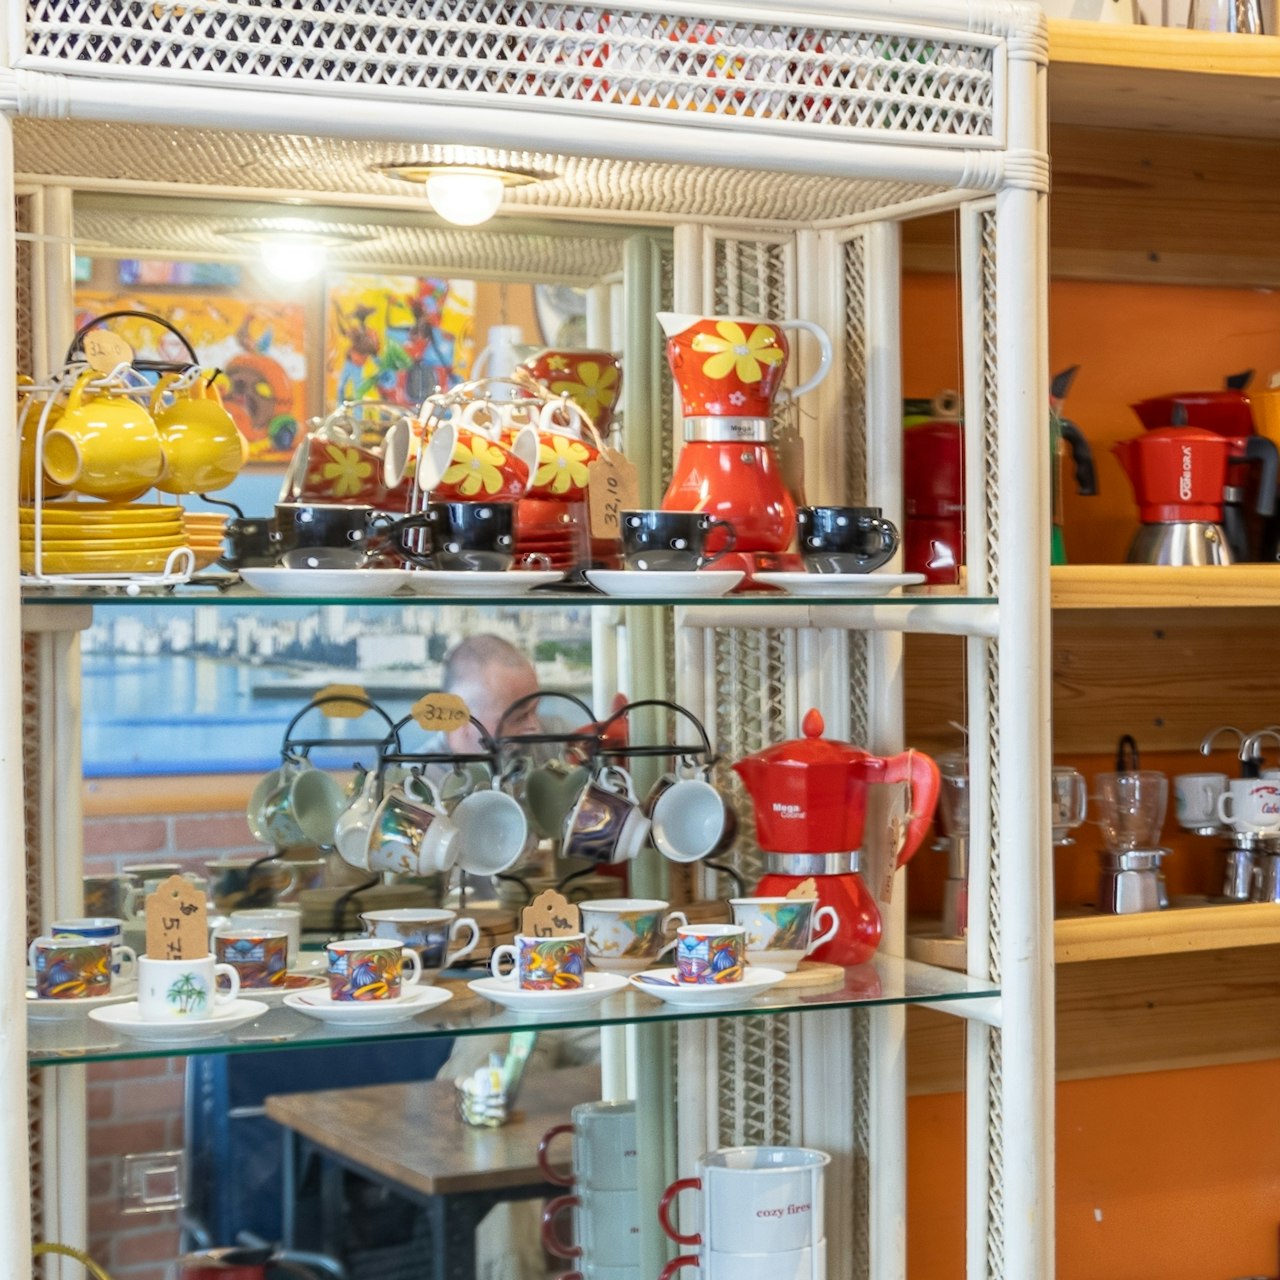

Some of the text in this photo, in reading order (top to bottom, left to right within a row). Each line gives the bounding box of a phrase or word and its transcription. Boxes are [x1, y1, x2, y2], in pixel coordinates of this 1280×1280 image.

[773, 803, 800, 813] Mega
[756, 1203, 811, 1219] cozy fires
